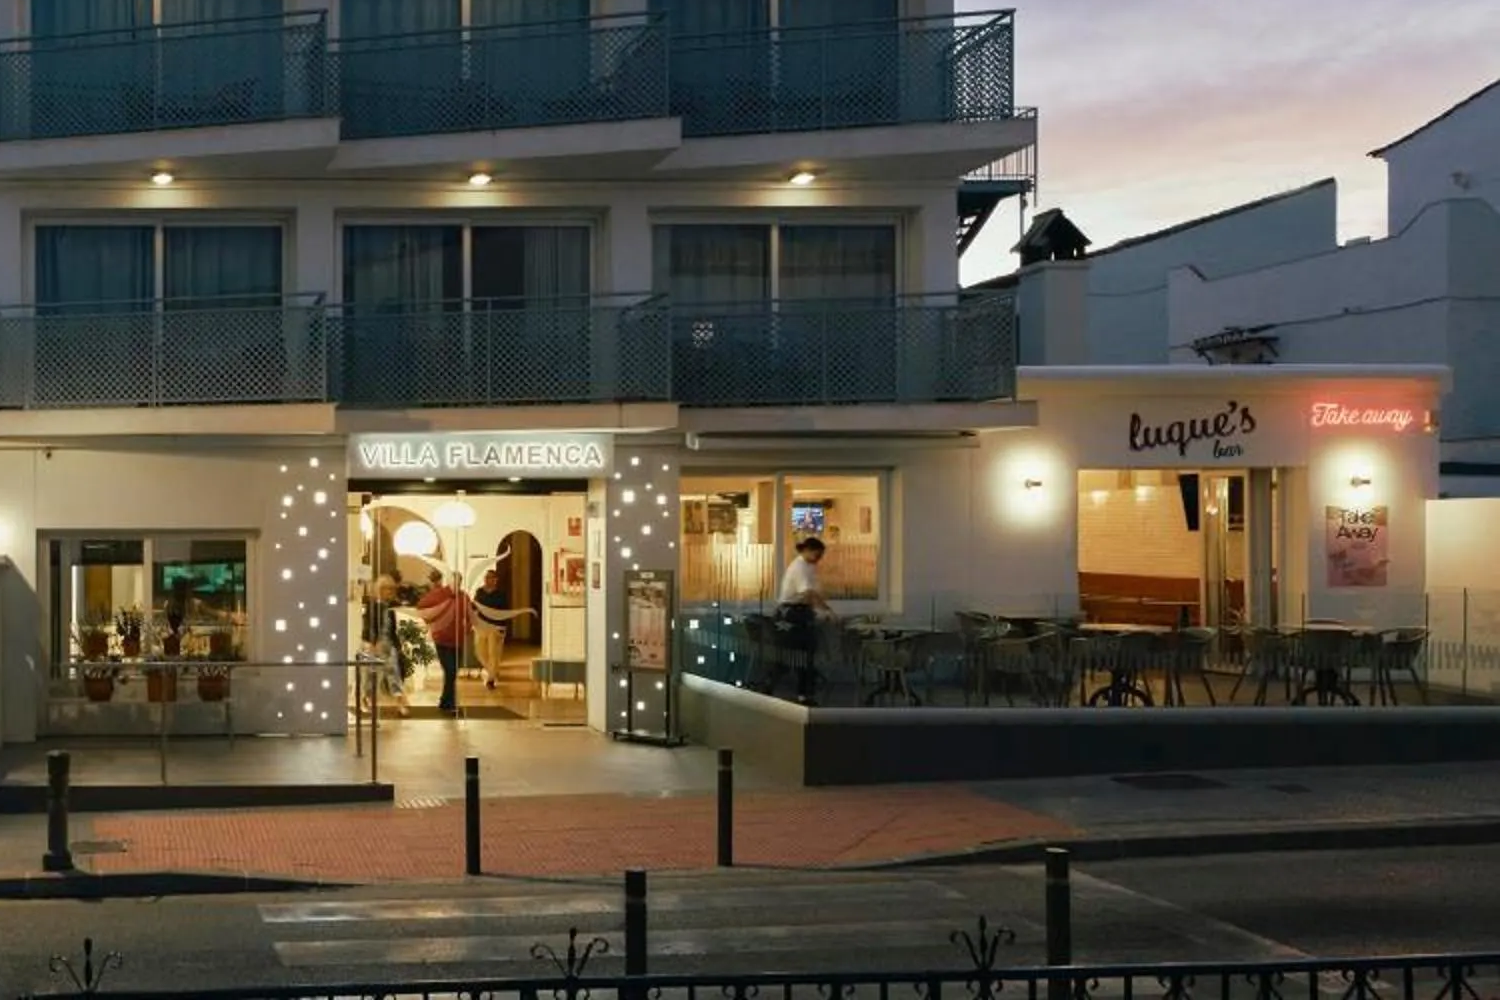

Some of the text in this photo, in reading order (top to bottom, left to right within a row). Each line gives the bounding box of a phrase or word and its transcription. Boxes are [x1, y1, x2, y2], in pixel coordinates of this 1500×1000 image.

[1129, 400, 1257, 457] luque's
[1311, 402, 1413, 432] Take away
[359, 442, 604, 467] VILLA FLAMENCA
[1213, 439, 1245, 459] bar
